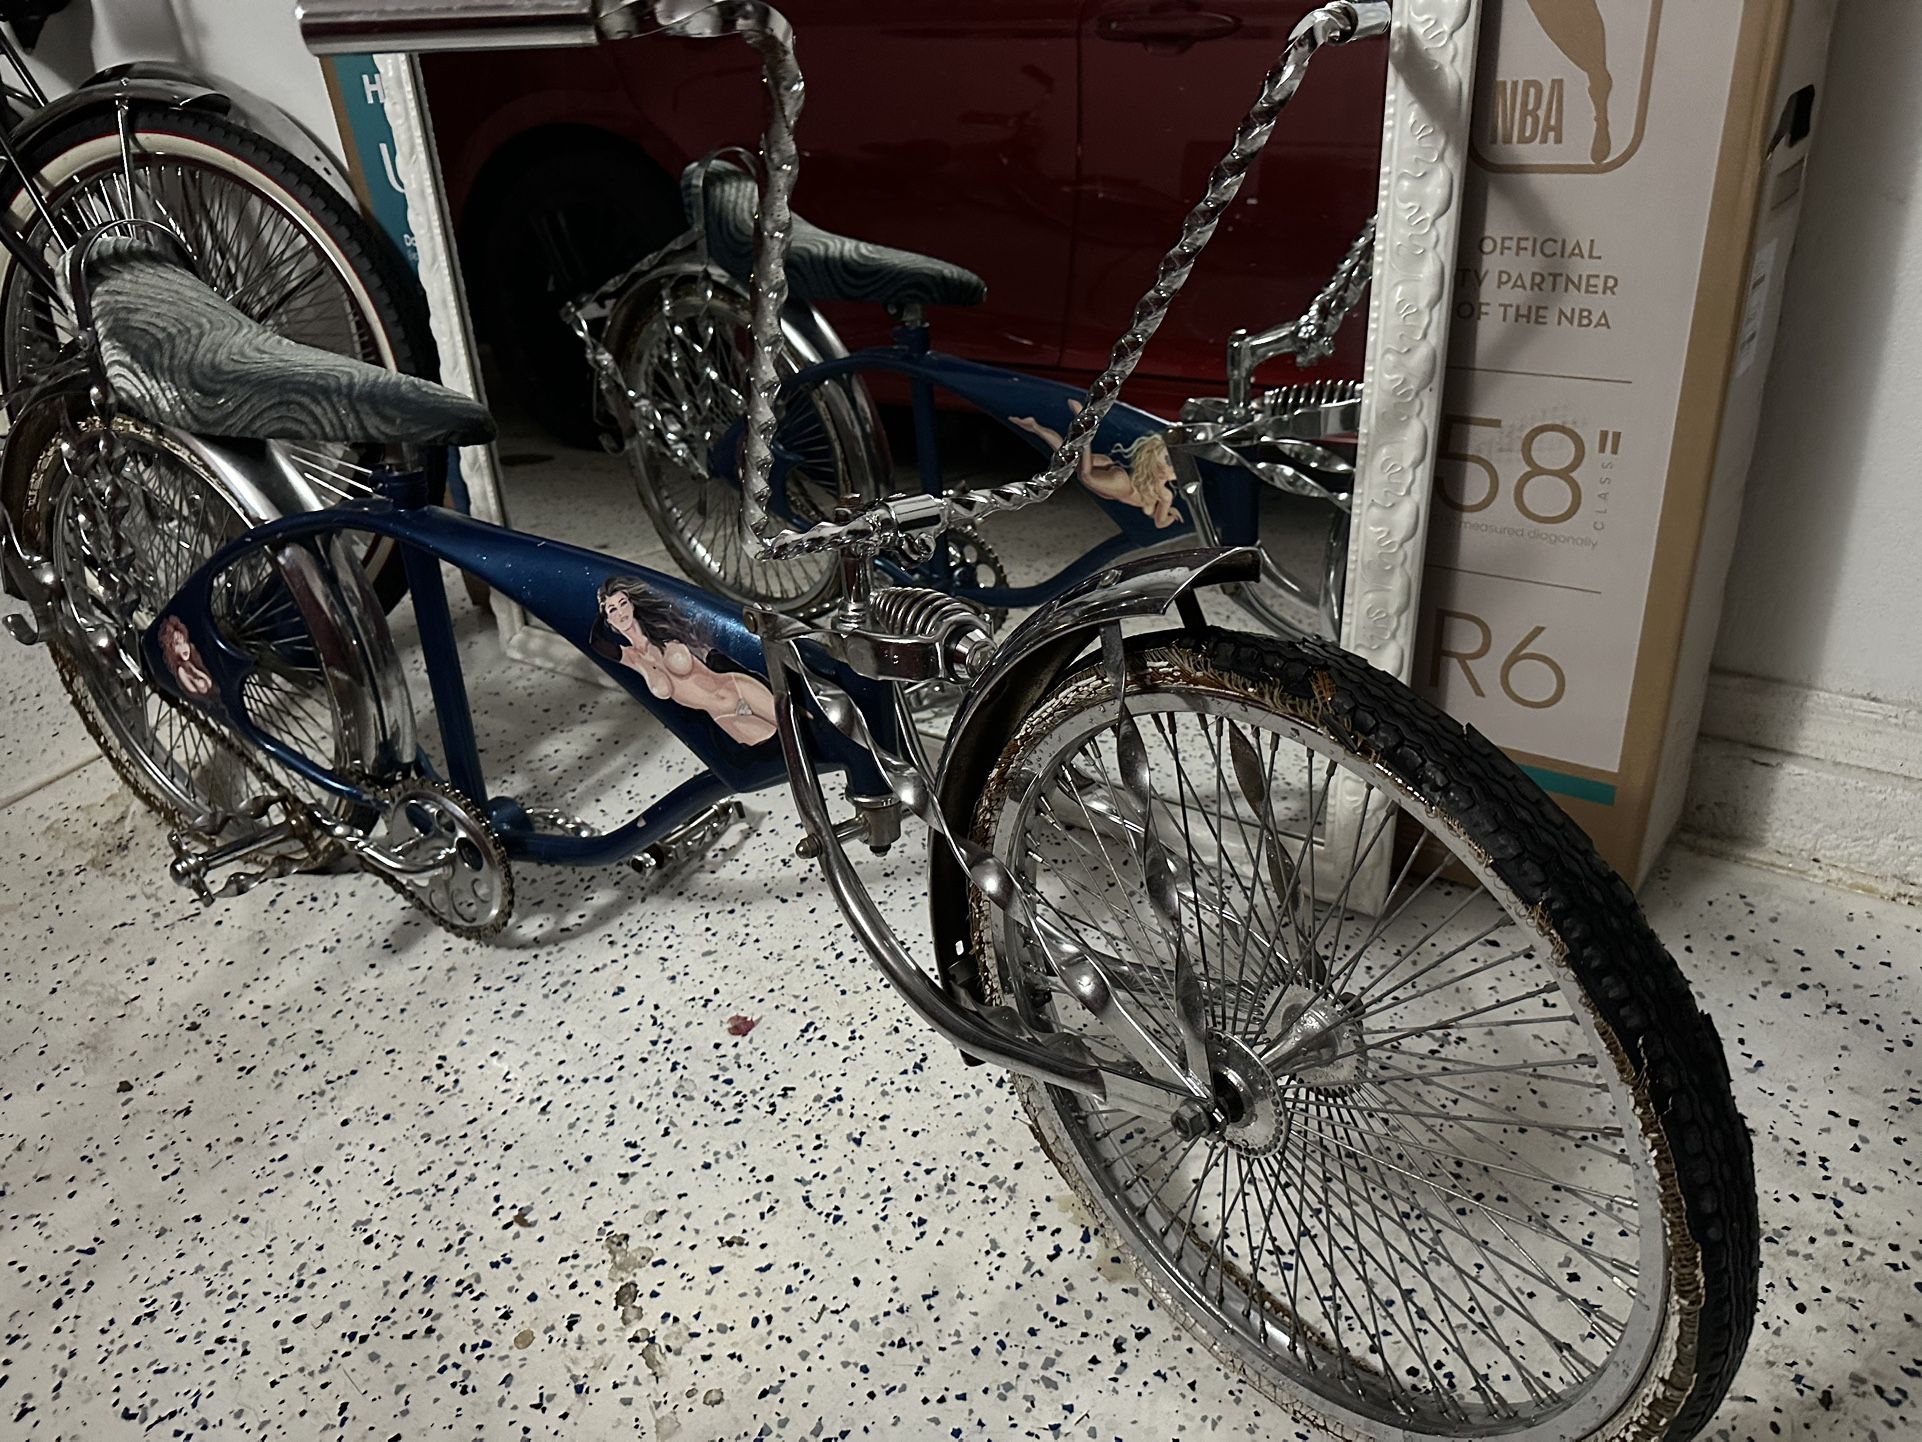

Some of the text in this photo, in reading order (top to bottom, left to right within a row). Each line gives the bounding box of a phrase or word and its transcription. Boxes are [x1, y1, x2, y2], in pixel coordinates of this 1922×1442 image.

[1489, 78, 1564, 145] NBA
[1479, 235, 1603, 261] OFFICIAL
[1456, 267, 1619, 296] TV PARTNER
[1455, 301, 1612, 330] OF THE NBA
[1592, 460, 1614, 531] CLASS
[1460, 519, 1525, 538] measured
[1527, 528, 1599, 550] diagonally
[1428, 607, 1566, 710] R6
